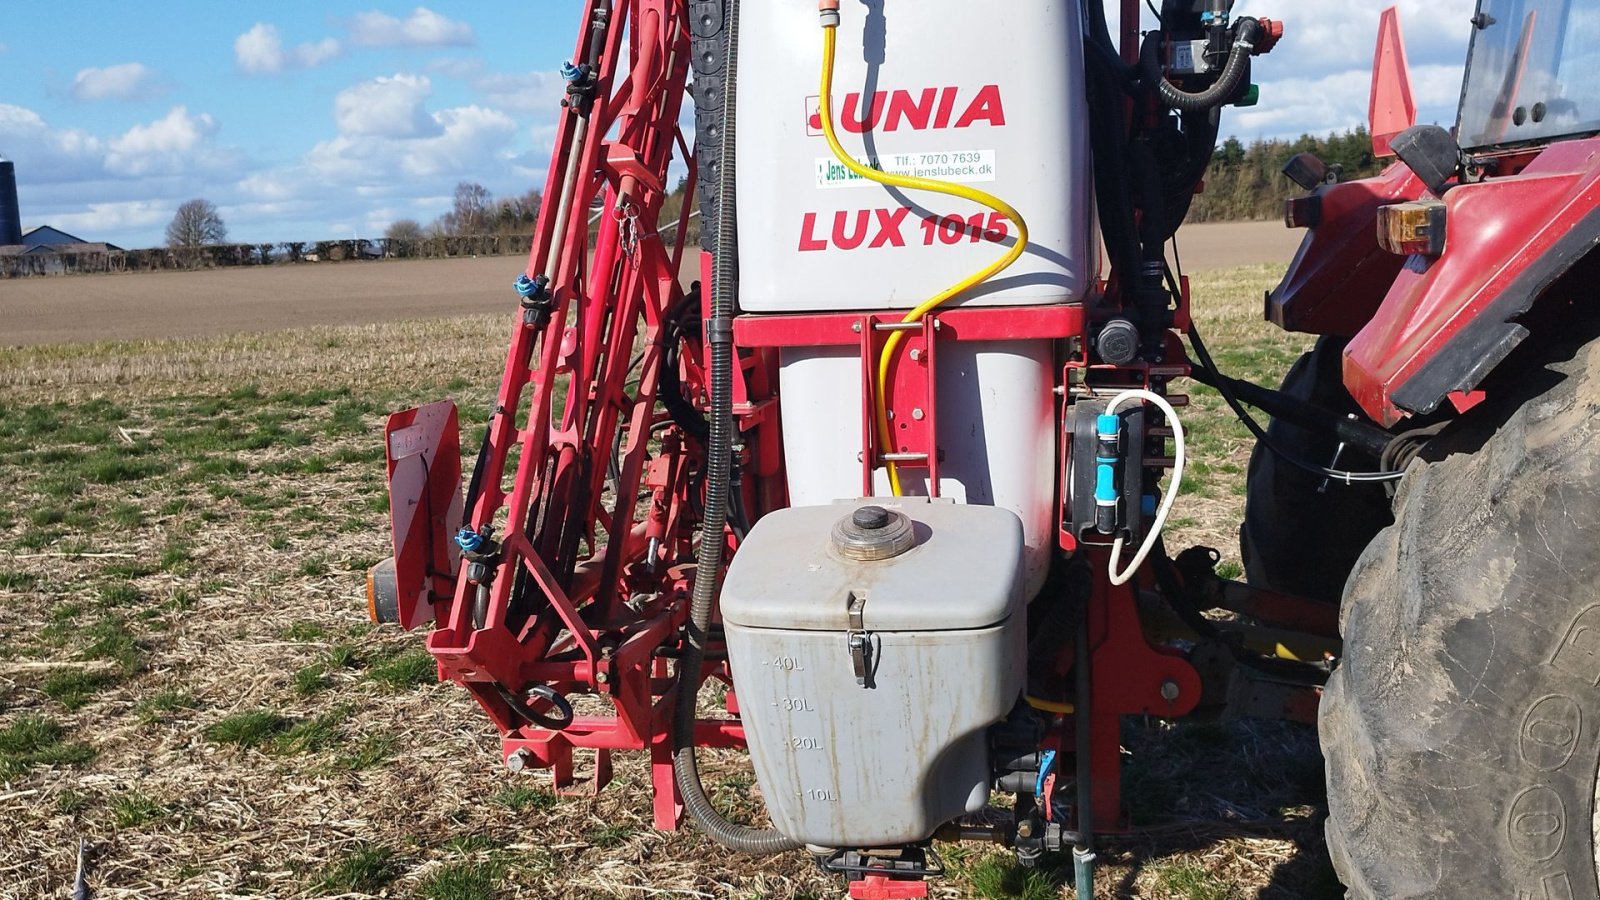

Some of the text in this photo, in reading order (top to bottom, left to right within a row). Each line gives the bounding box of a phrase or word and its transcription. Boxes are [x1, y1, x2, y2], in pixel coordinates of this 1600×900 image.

[840, 85, 1006, 134] UNIA
[894, 152, 981, 166] Tlf.: 7070 7639
[826, 157, 880, 181] Jens Luk
[798, 207, 1010, 252] LUX 1015
[774, 656, 805, 672] 40L
[783, 698, 814, 712] 30L
[792, 737, 824, 751] 20L
[808, 788, 838, 802] 10L
